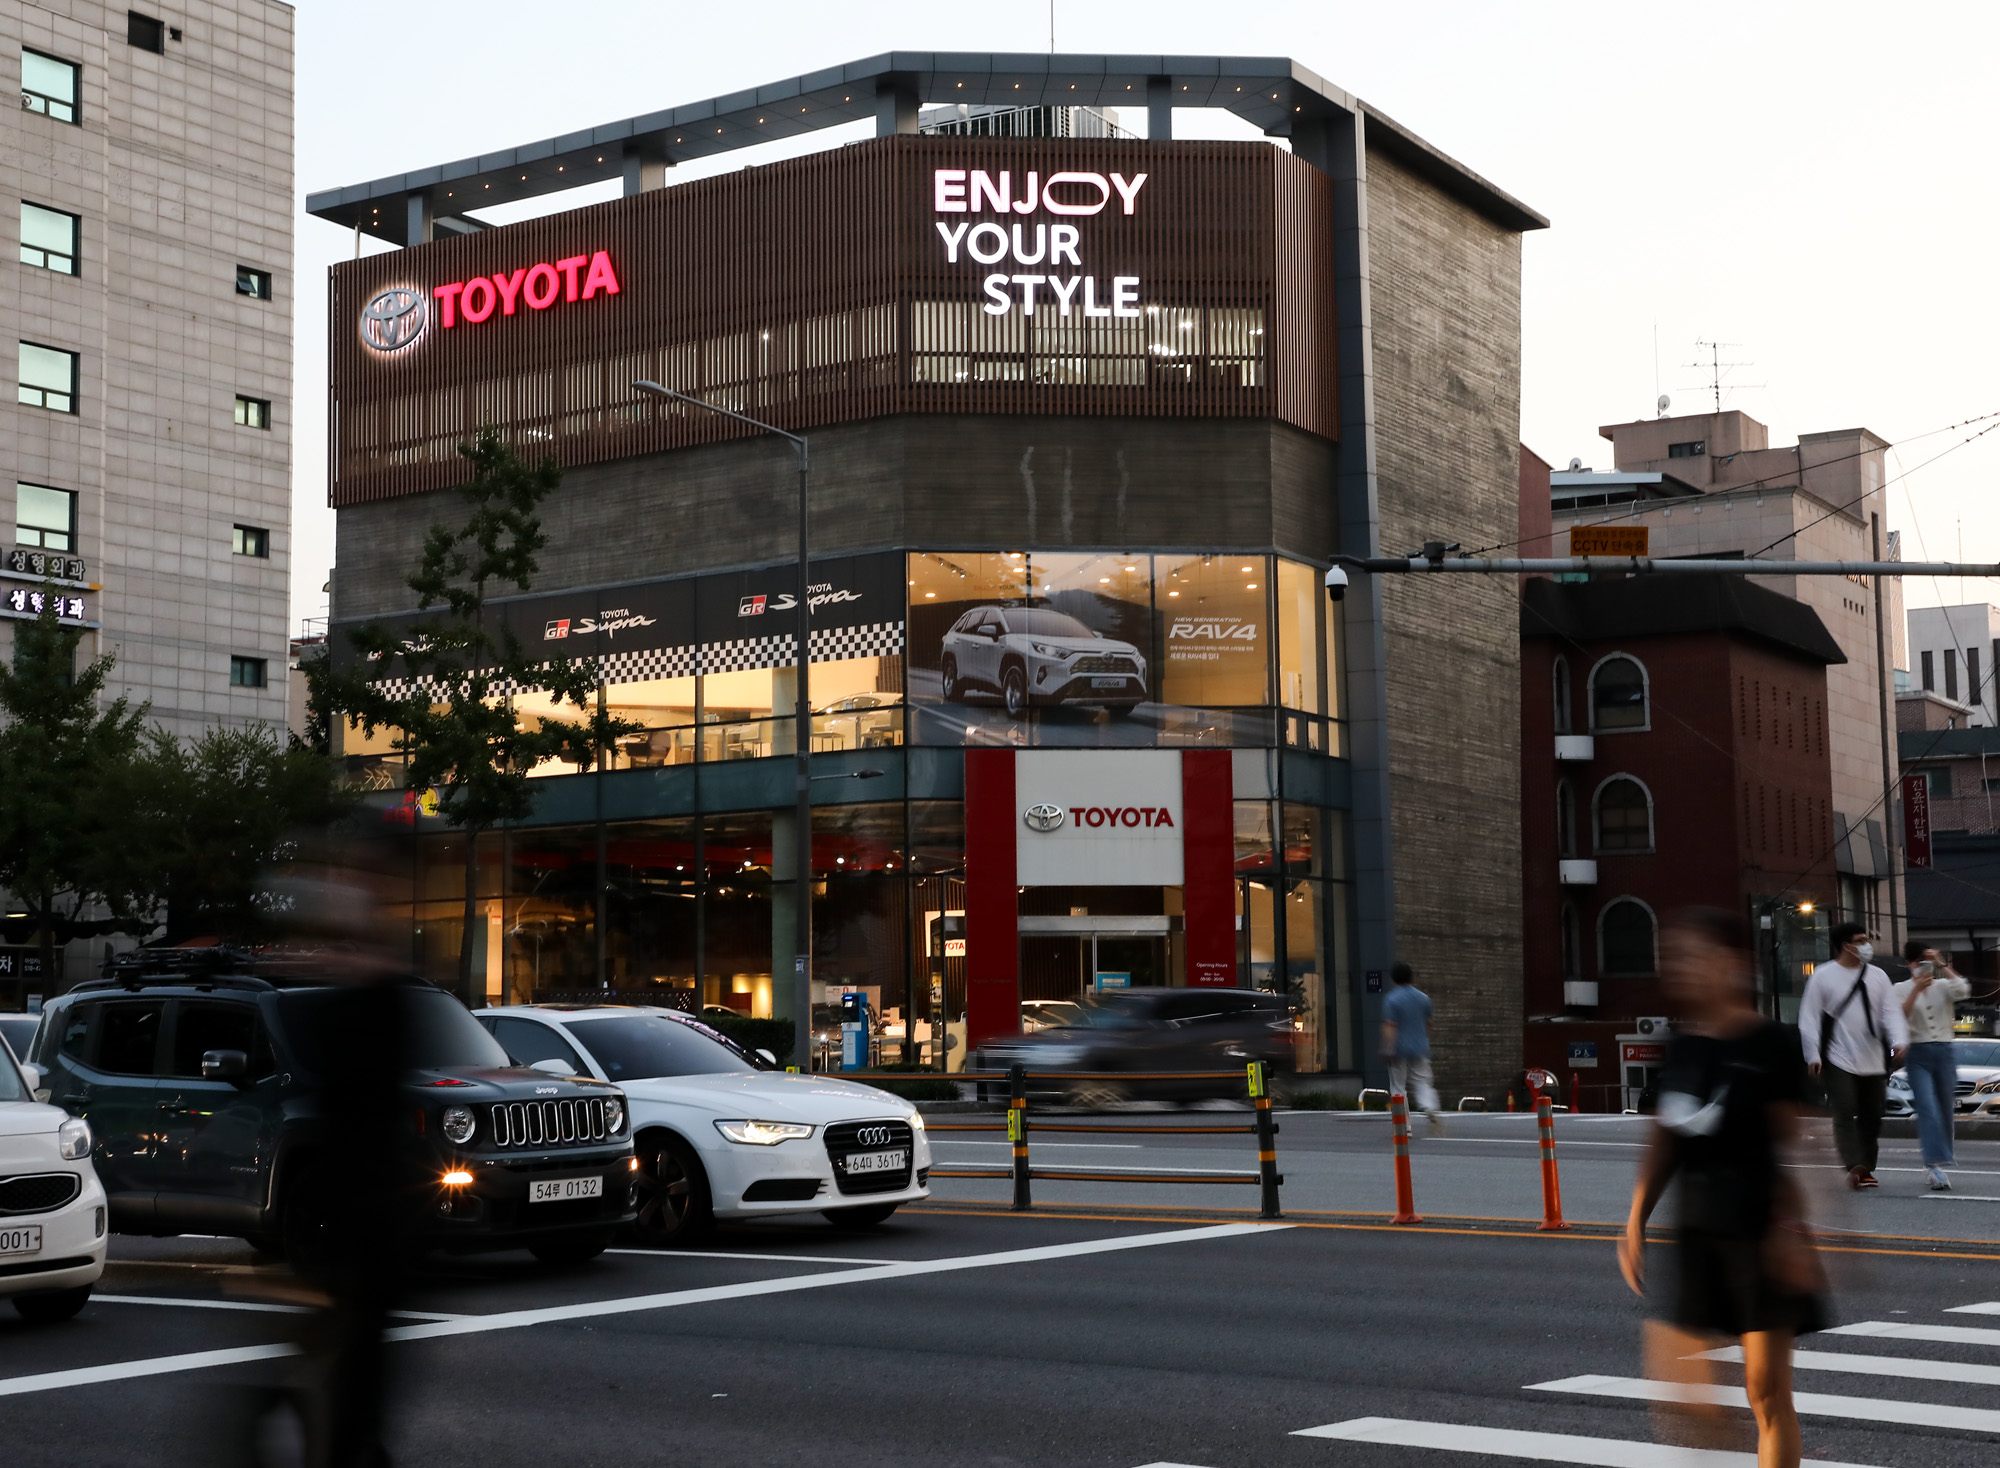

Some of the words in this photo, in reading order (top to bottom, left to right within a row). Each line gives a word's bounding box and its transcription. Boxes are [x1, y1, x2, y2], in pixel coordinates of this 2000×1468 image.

[935, 169, 1148, 216] ENJOY
[935, 222, 1082, 265] YOUR
[434, 250, 620, 328] TOYOTA
[983, 273, 1140, 317] STYLE
[1572, 540, 1608, 552] CCTV
[12, 552, 84, 580] 성형외과
[806, 583, 832, 594] OYOTA
[769, 590, 862, 615] Spra
[600, 608, 629, 619] TOYOTA
[572, 615, 657, 639] Supra
[1169, 624, 1257, 640] RAV4
[1069, 807, 1174, 827] TOYOTA
[1627, 1048, 1634, 1058] P
[877, 1154, 900, 1168] 3617
[536, 1183, 560, 1199] 54루
[566, 1179, 597, 1197] 0132
